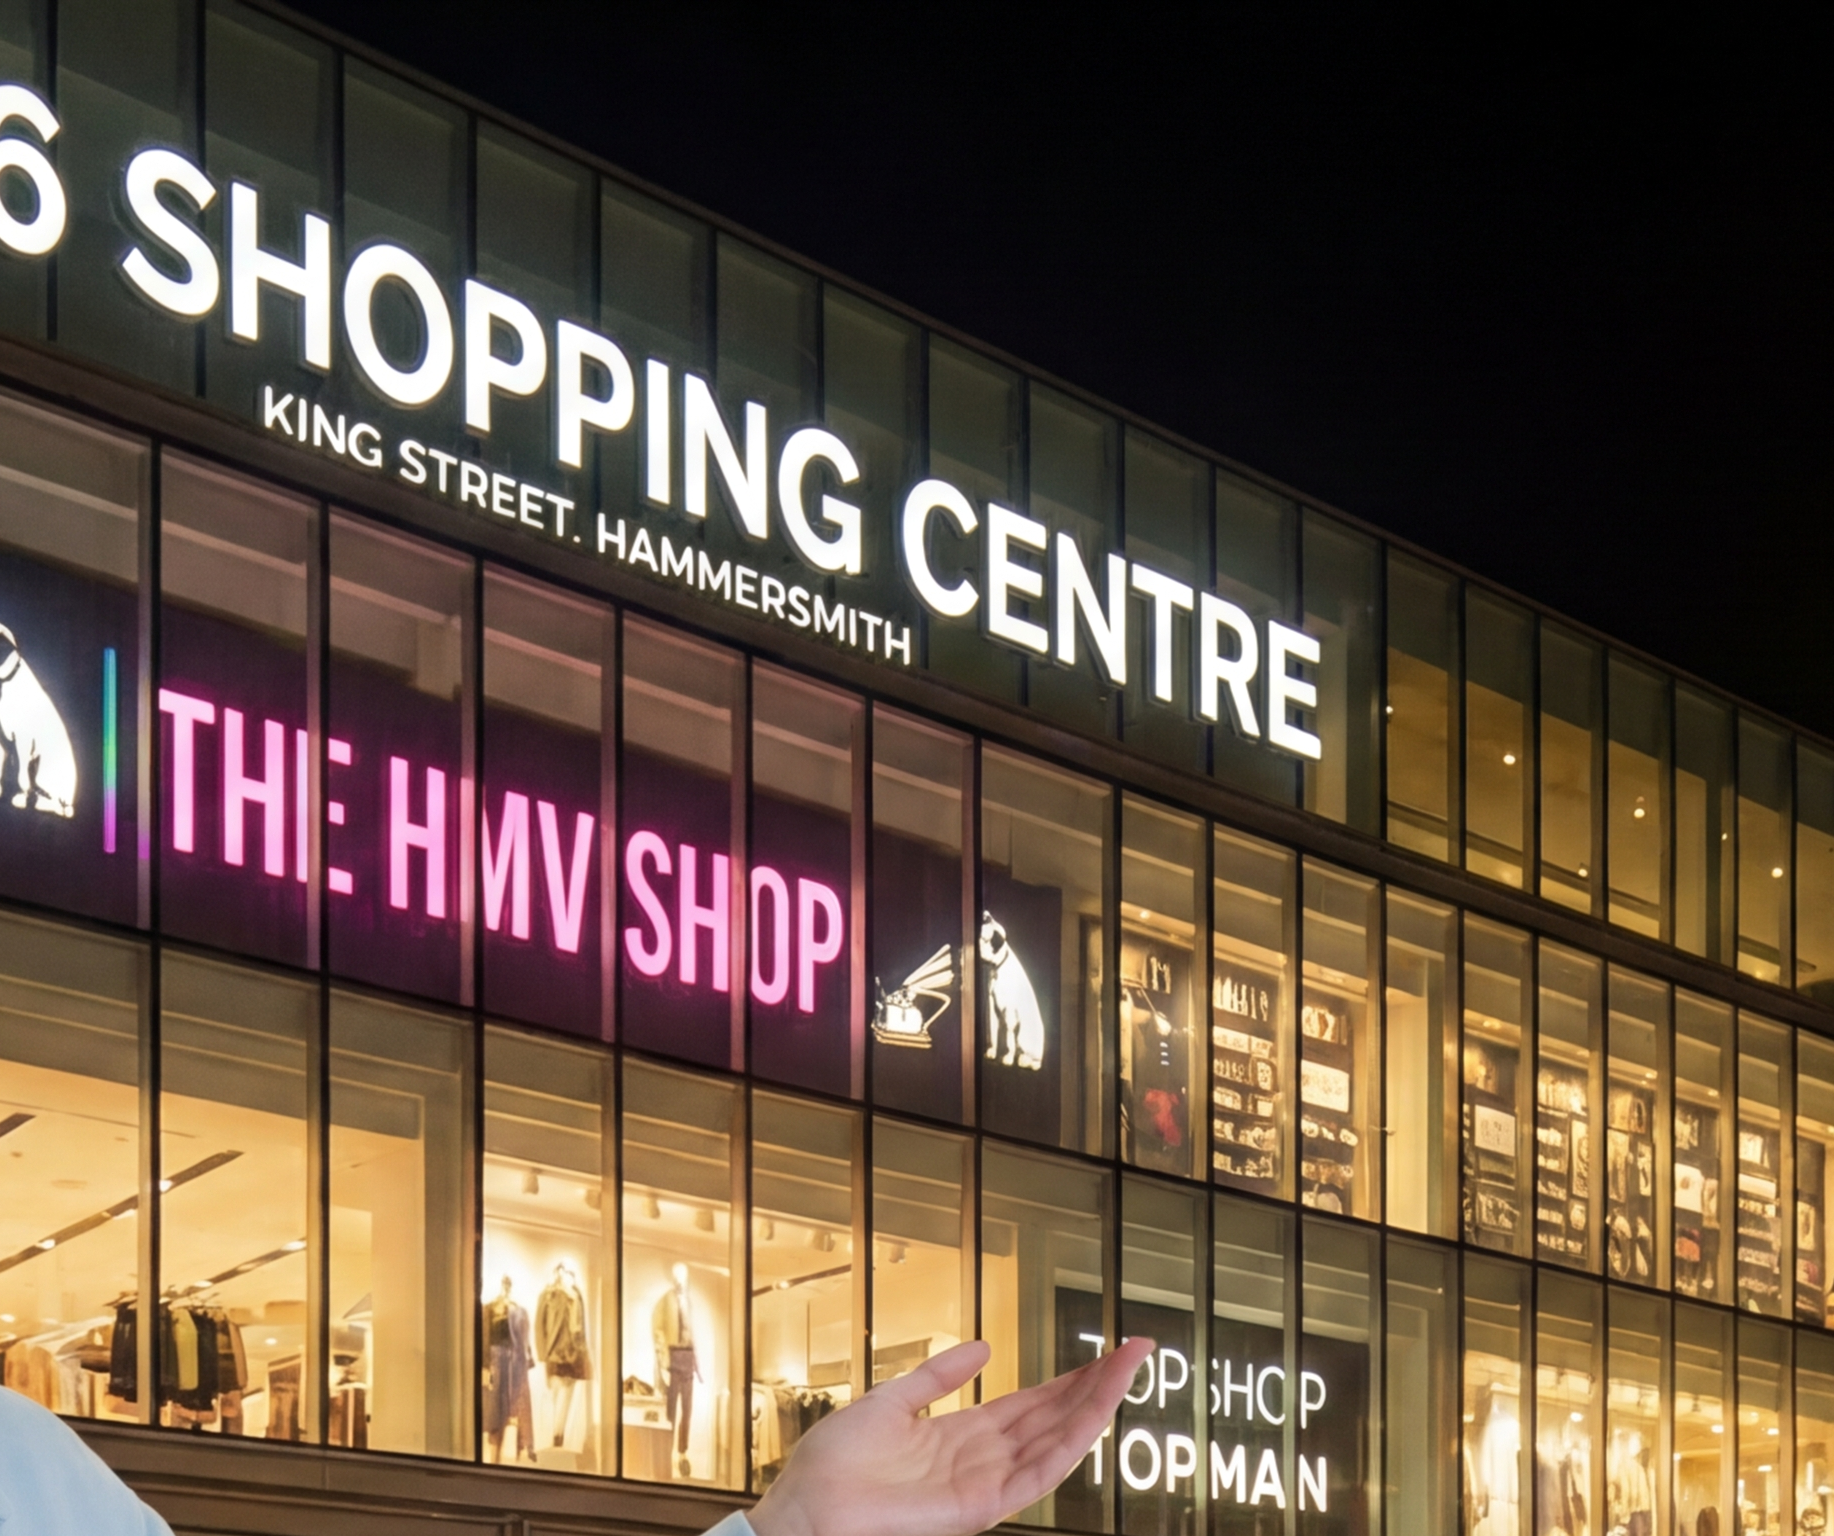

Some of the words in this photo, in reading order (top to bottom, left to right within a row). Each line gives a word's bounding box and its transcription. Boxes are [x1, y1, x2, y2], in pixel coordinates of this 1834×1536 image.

[121, 148, 862, 575] SHOPPING
[901, 478, 1323, 760] CENTRE
[264, 385, 383, 468] KING
[399, 439, 581, 544] STREET.
[597, 512, 911, 666] HAMMERSMITH
[158, 687, 354, 896] THE
[389, 755, 596, 954] HMV
[624, 829, 844, 1014] SHOP
